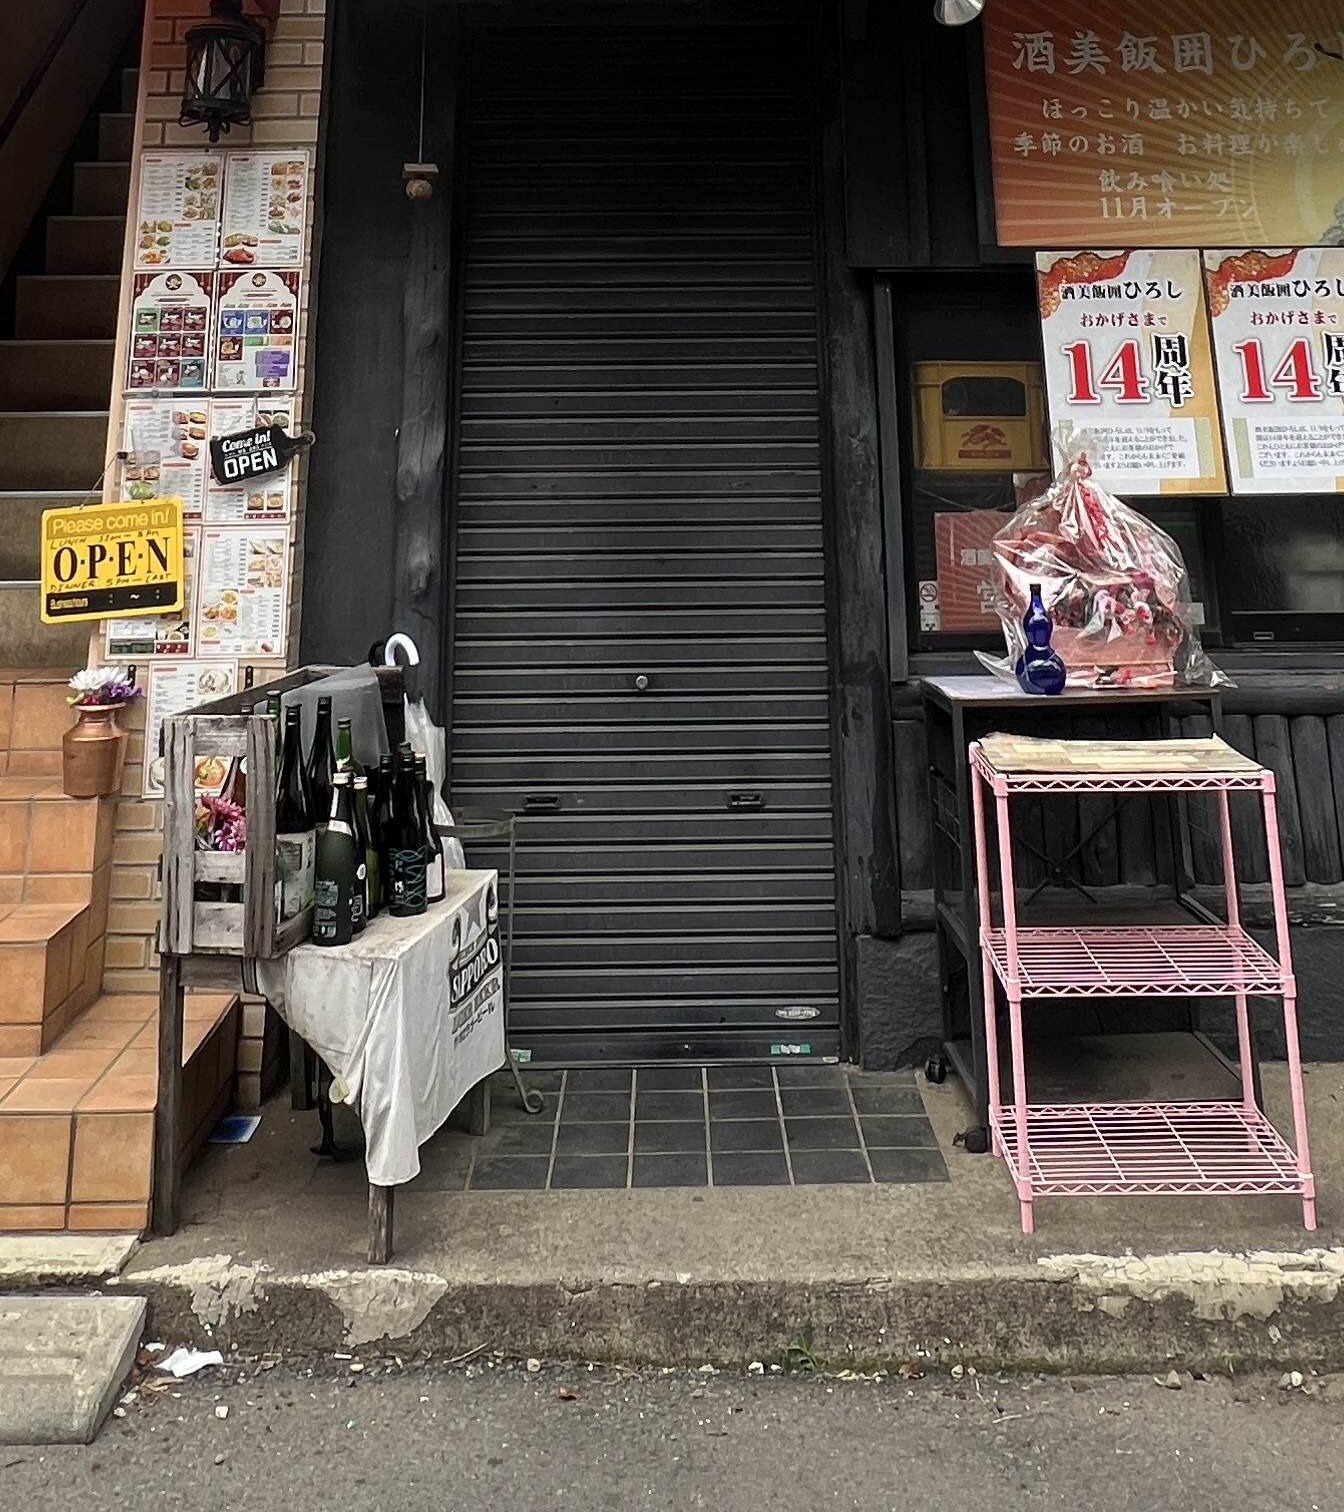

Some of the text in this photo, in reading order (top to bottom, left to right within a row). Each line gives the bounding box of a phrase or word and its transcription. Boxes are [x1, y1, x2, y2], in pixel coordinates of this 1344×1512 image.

[1013, 132, 1144, 157] 季節のお酒
[1099, 169, 1233, 193] 飲み喰い処
[1099, 197, 1258, 220] 11月オープン
[1080, 312, 1167, 327] おかげさまで
[1250, 310, 1337, 325] おかげさまで
[222, 438, 253, 453] Come
[254, 430, 271, 444] in!
[224, 448, 278, 478] OPEN
[53, 508, 170, 535] Please come in!
[451, 938, 498, 1003] SPPORO
